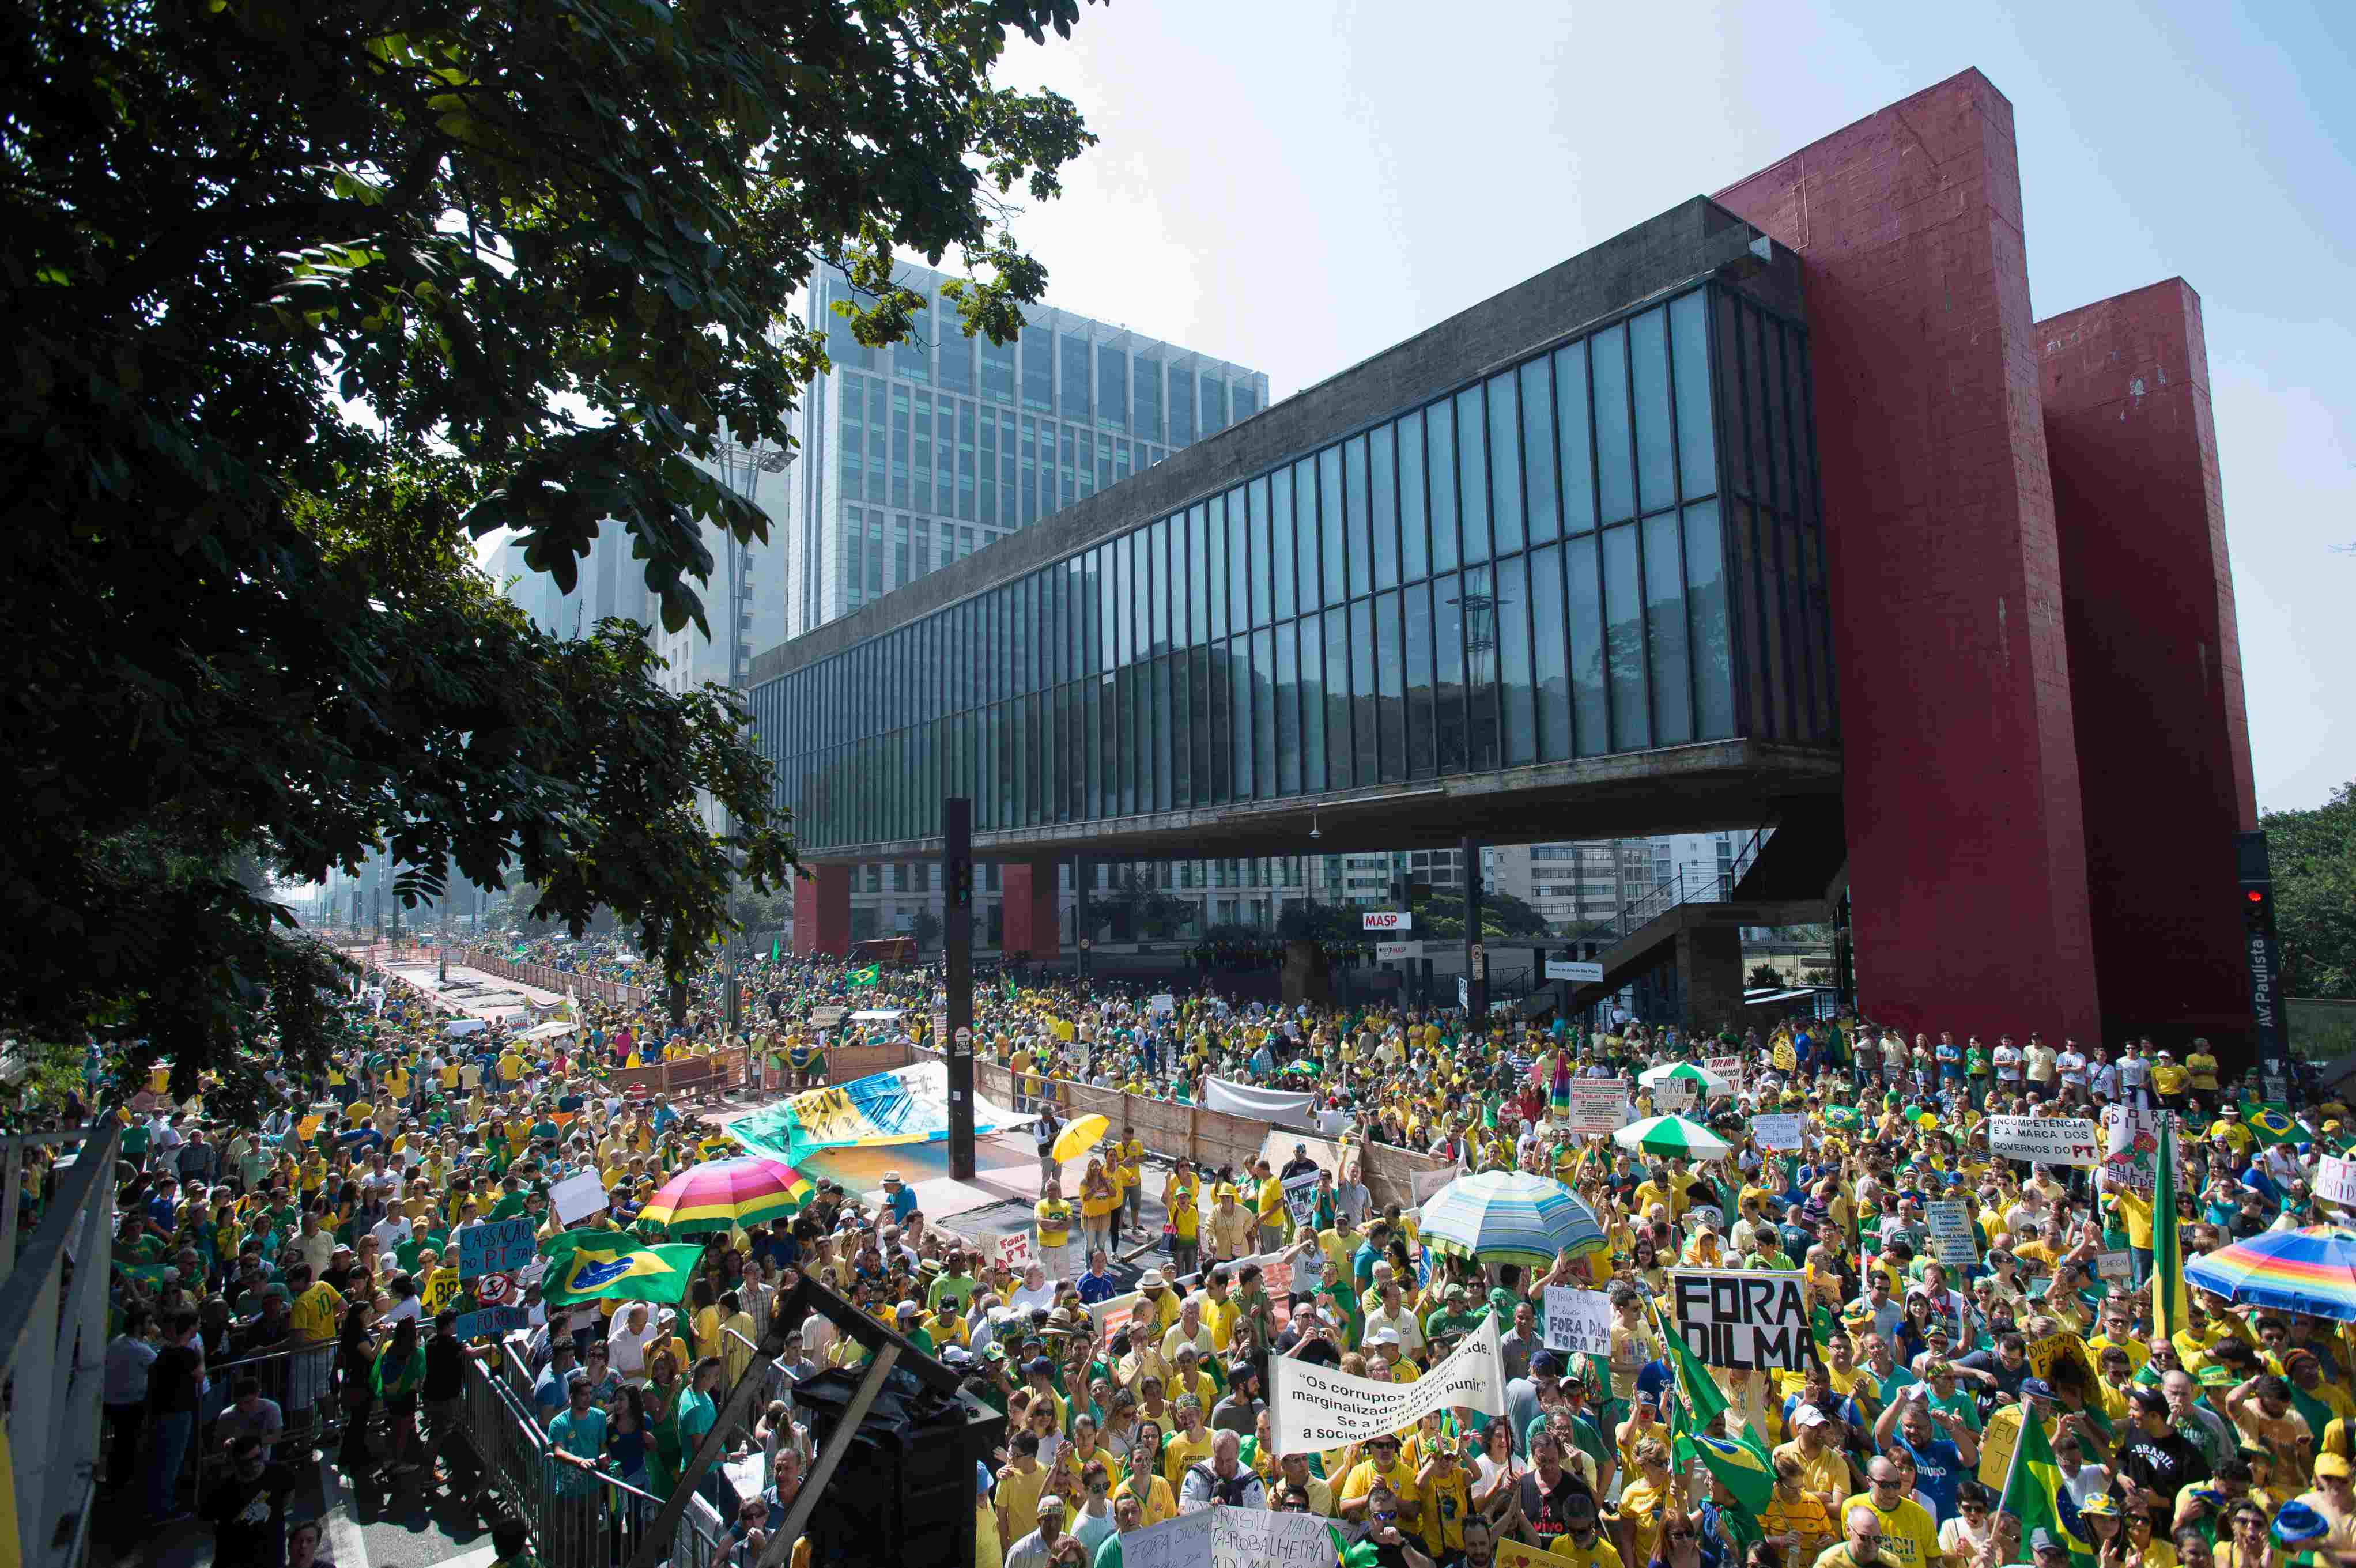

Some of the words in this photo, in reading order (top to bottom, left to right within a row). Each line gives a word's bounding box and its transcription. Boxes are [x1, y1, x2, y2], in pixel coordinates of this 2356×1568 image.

[1365, 915, 1398, 927] MASP
[2251, 939, 2271, 1003] Paulista
[1711, 1058, 1736, 1068] DILMA
[1653, 1078, 1684, 1094] FORA
[2017, 1129, 2058, 1139] MARCA
[2064, 1131, 2089, 1139] DOS
[1993, 1142, 2050, 1153] GOVERNOS
[2055, 1146, 2070, 1154] DO
[1000, 1234, 1026, 1250] FORA
[462, 1258, 477, 1271] DO
[485, 1247, 508, 1269] PT
[1006, 1243, 1027, 1264] PT
[435, 1280, 457, 1305] 88
[1675, 1275, 1809, 1327] FORA
[317, 1292, 332, 1320] 10
[1549, 1316, 1583, 1334] FORA
[1554, 1332, 1588, 1351] FORA
[1595, 1337, 1607, 1354] PT
[1681, 1321, 1821, 1373] DILMA
[1292, 1390, 1406, 1416] marginalizados
[1331, 1381, 1405, 1404] corruptos
[1303, 1427, 1312, 1439] a
[1316, 1424, 1393, 1441] sociedade
[1337, 1415, 1356, 1427] Se
[1362, 1420, 1370, 1428] a
[1993, 1420, 2018, 1445] EU
[1129, 1534, 1171, 1563] FORA
